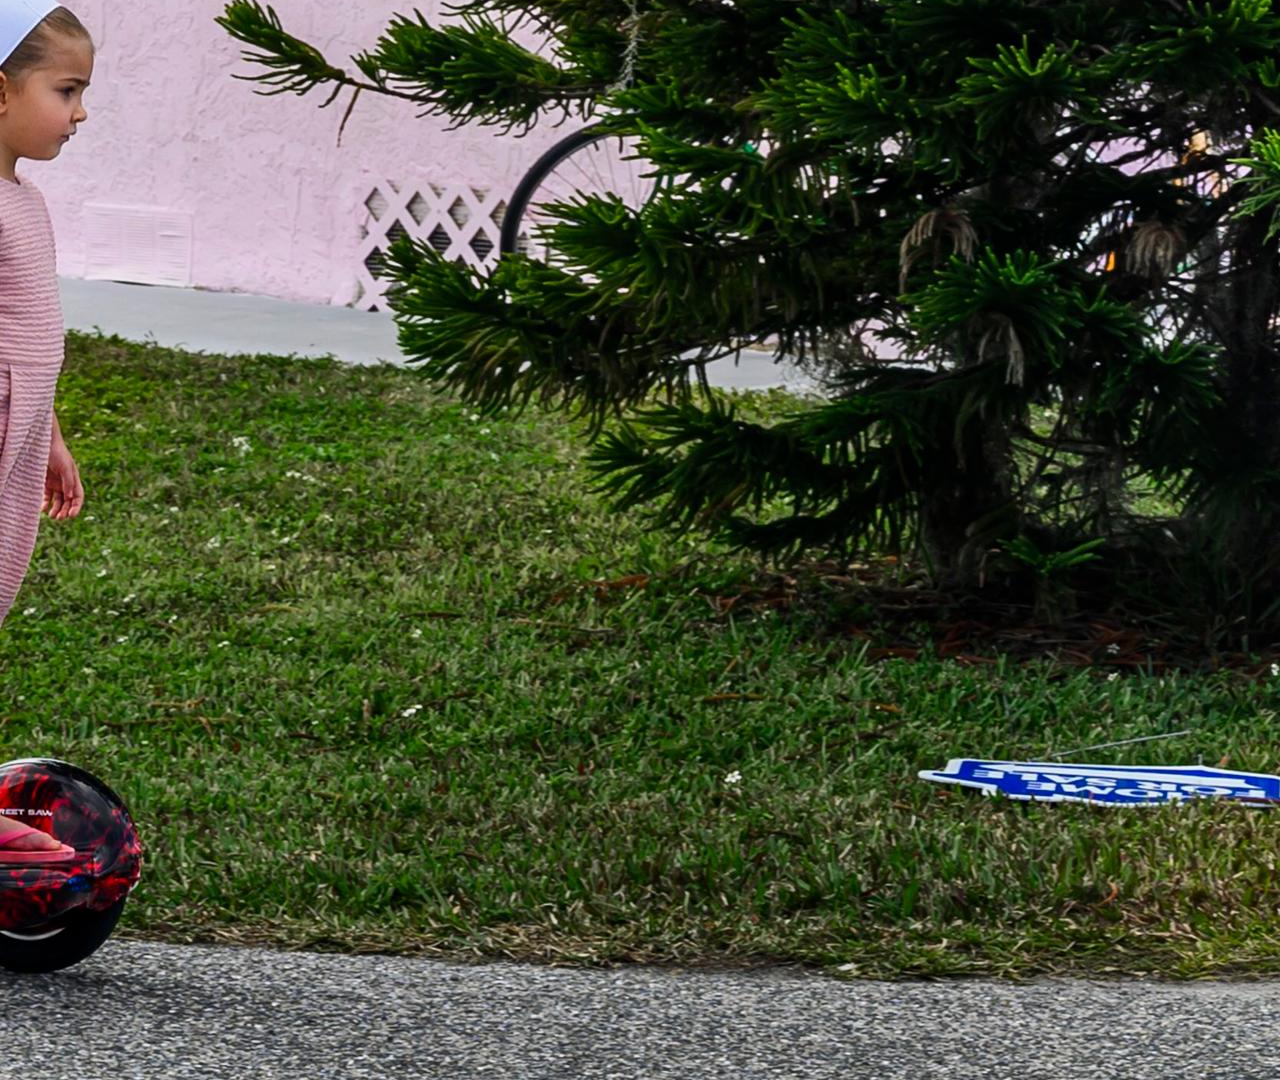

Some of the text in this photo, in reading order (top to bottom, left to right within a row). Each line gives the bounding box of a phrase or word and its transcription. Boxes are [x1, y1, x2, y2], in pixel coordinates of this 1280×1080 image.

[972, 769, 1266, 798] FOR SALE
[28, 809, 53, 817] SAW
